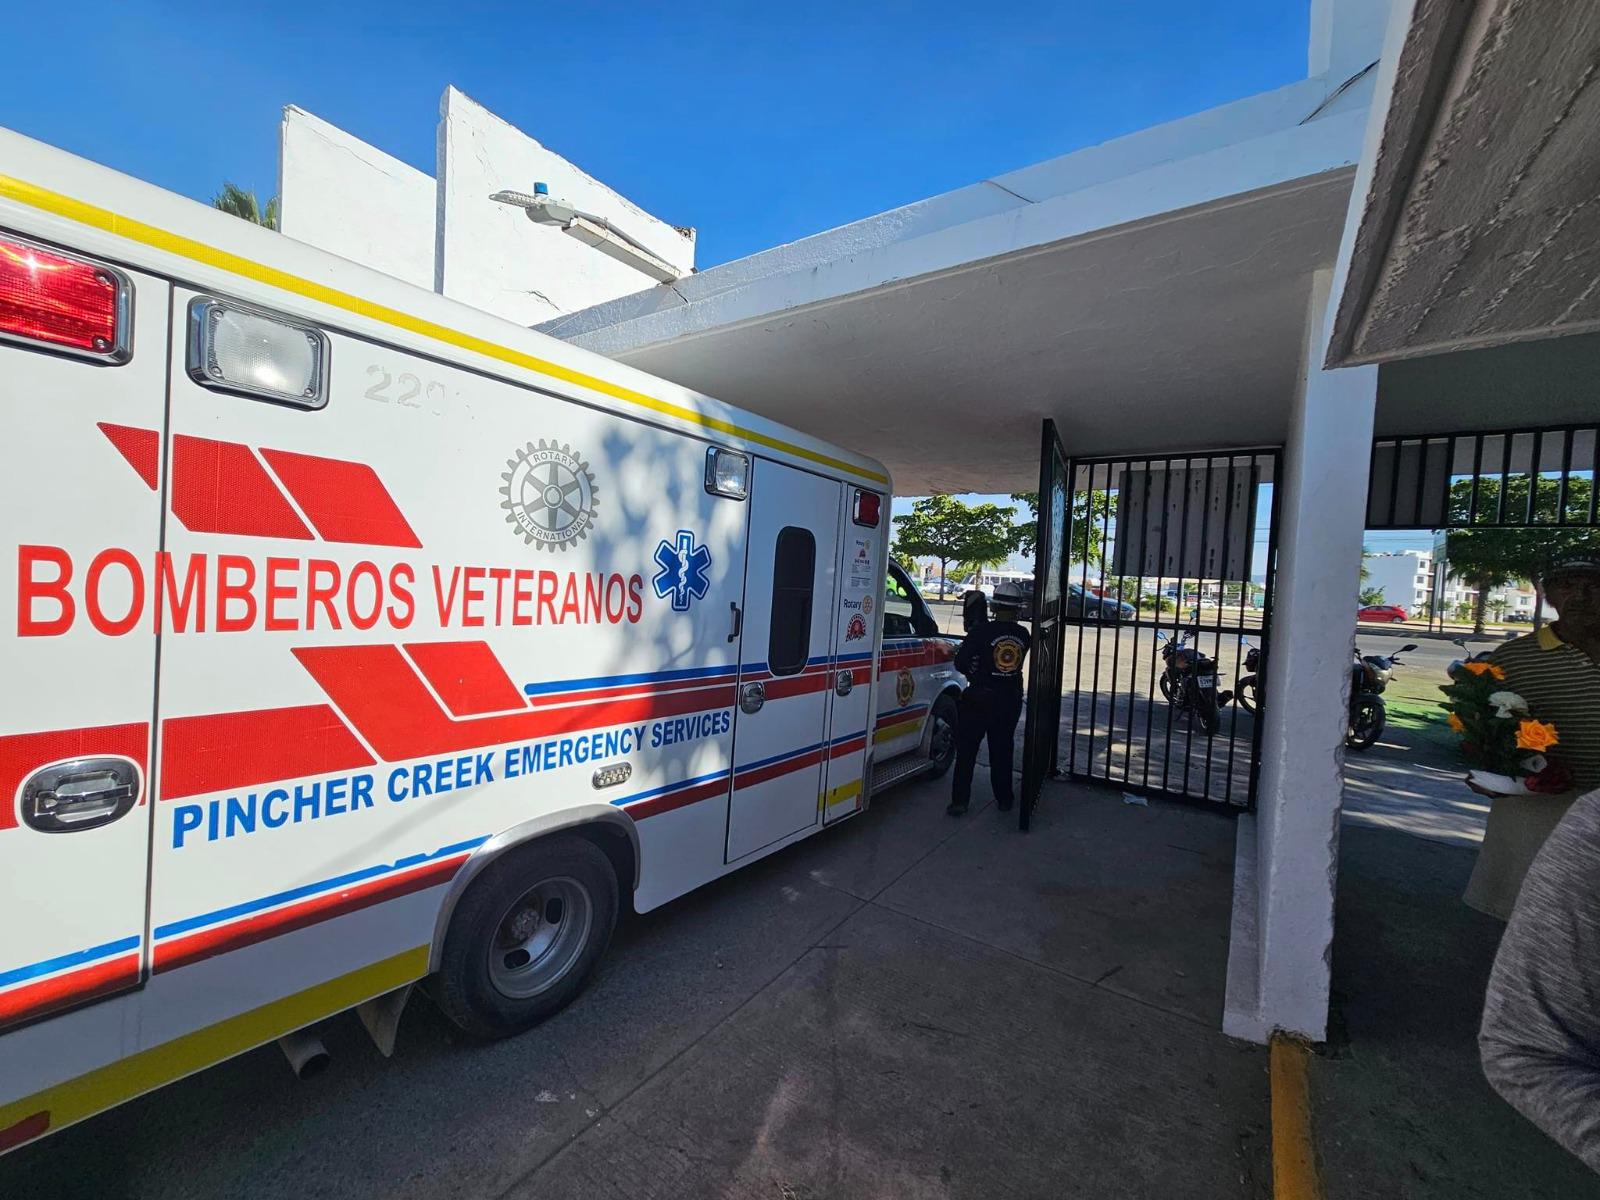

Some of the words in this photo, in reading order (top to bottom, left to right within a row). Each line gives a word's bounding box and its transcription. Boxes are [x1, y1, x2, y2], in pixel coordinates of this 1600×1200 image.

[533, 451, 575, 467] ROTARY
[517, 511, 586, 541] INTERNATIONAL
[17, 544, 416, 637] BOMBEROS
[433, 564, 643, 629] VETERANOS
[172, 772, 375, 849] PINCHER
[387, 752, 496, 803] CREEK
[504, 725, 646, 779] EMERGENCY
[651, 709, 731, 747] SERVICES
